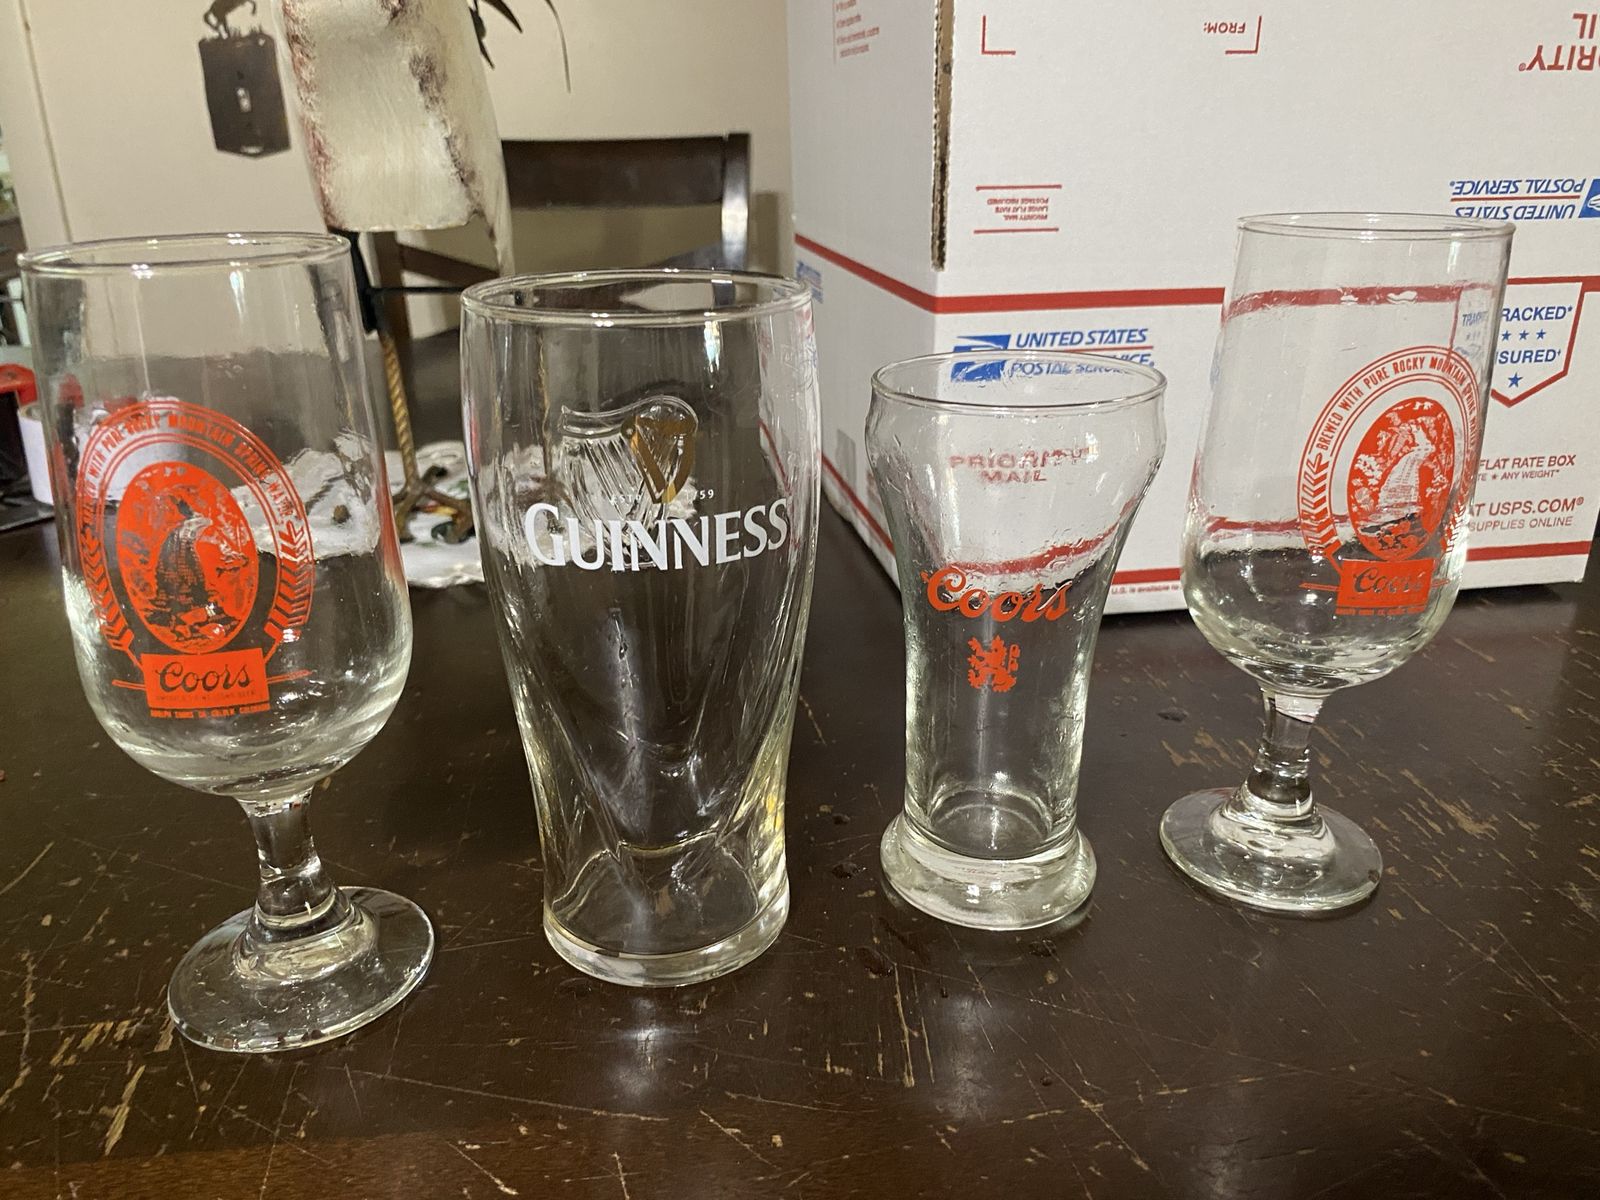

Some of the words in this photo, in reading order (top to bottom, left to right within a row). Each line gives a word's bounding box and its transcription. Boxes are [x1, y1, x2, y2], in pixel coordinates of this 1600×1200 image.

[1203, 21, 1246, 34] FROM:
[1526, 178, 1587, 194] POSTAL
[1454, 206, 1512, 221] STATES
[1513, 204, 1576, 220] UNITED
[1016, 331, 1084, 348] UNITED
[1085, 328, 1148, 345] STATES
[1316, 412, 1344, 451] BREWED
[1338, 386, 1365, 412] WITH
[1363, 366, 1390, 390] PURE
[1392, 356, 1425, 375] ROCKY
[1428, 356, 1468, 386] MOUNTAIN
[1511, 456, 1545, 469] RATE
[1547, 454, 1577, 467] BOX
[980, 470, 1047, 484] MAIL
[1500, 471, 1520, 480] ANY
[1469, 519, 1527, 532] SUPPLIES
[1528, 516, 1574, 529] ONLINE
[524, 498, 789, 573] GUINNESS
[920, 565, 1073, 622] Coors
[155, 661, 250, 693] Coors
